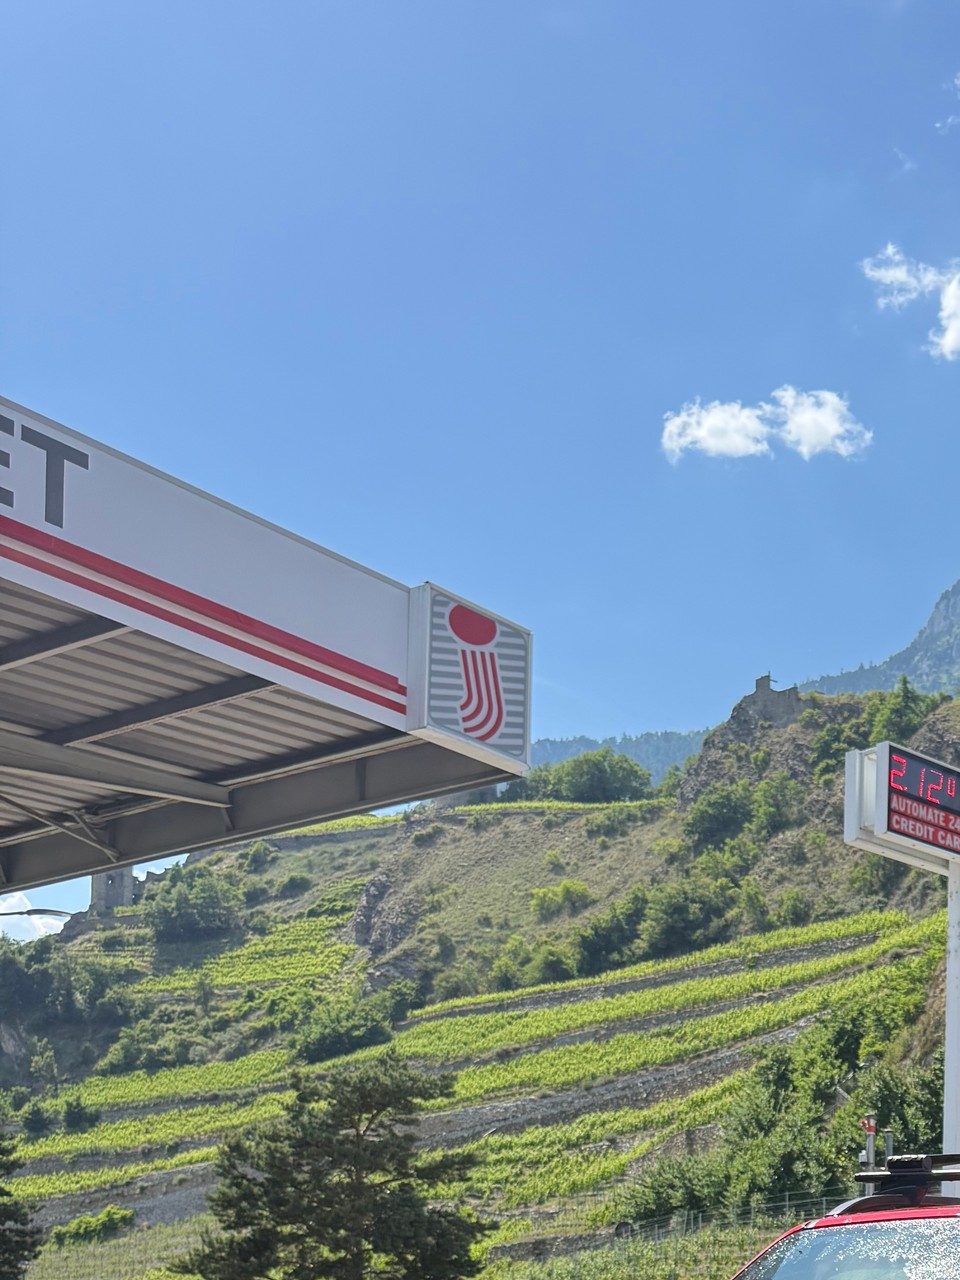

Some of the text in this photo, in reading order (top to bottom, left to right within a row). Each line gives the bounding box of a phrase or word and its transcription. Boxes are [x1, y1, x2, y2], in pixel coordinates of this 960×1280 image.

[0, 414, 89, 528] T
[891, 795, 946, 827] AUTOMATE
[891, 814, 935, 841] CREDIT
